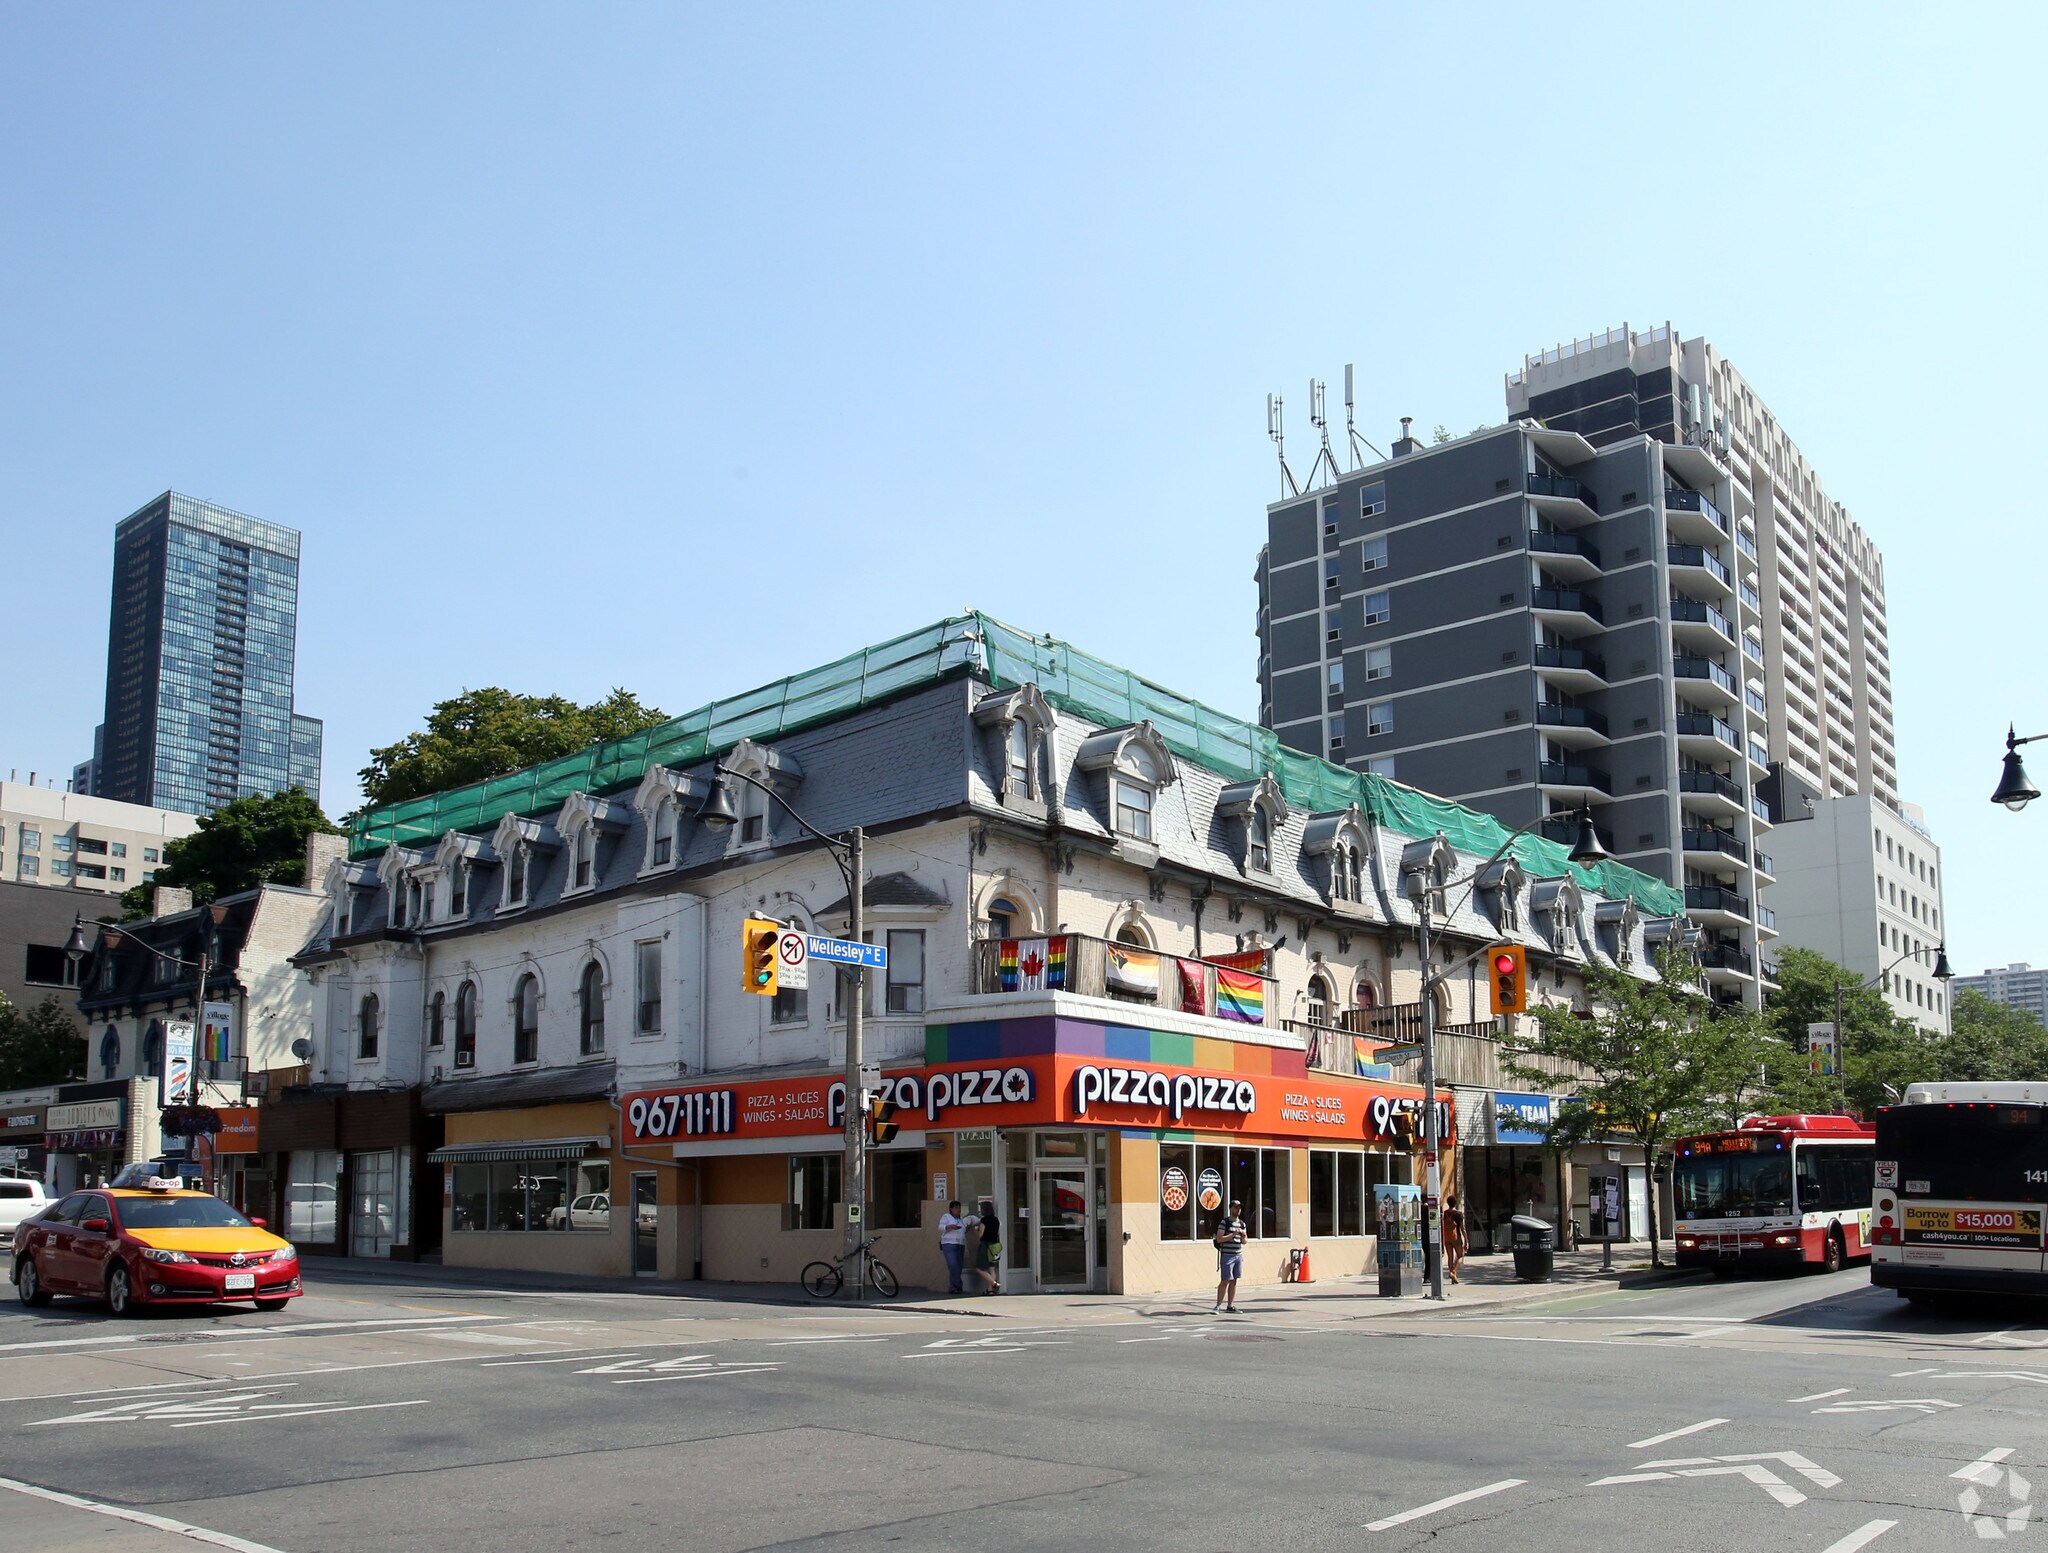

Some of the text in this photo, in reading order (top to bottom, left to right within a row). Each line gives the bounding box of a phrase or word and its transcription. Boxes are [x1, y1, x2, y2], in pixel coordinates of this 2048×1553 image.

[809, 937, 881, 963] Wellesley St E
[747, 1091, 819, 1108] PIZZA SLICES
[1077, 1065, 1255, 1120] pizza pizza
[1285, 1093, 1342, 1109] PIZZA SLICES
[743, 1107, 825, 1123] WINGS SALADS
[1281, 1108, 1346, 1125] WINGS SALADS
[1520, 1105, 1548, 1124] TEAM
[2010, 1109, 2029, 1124] 94
[222, 1123, 256, 1133] Freedom
[1694, 1141, 1712, 1153] 94A
[155, 1180, 180, 1188] co-op
[1906, 1208, 1949, 1219] Borrow
[1956, 1213, 2013, 1228] $15,000
[1920, 1219, 1949, 1229] up to
[1990, 1235, 2020, 1243] Locations
